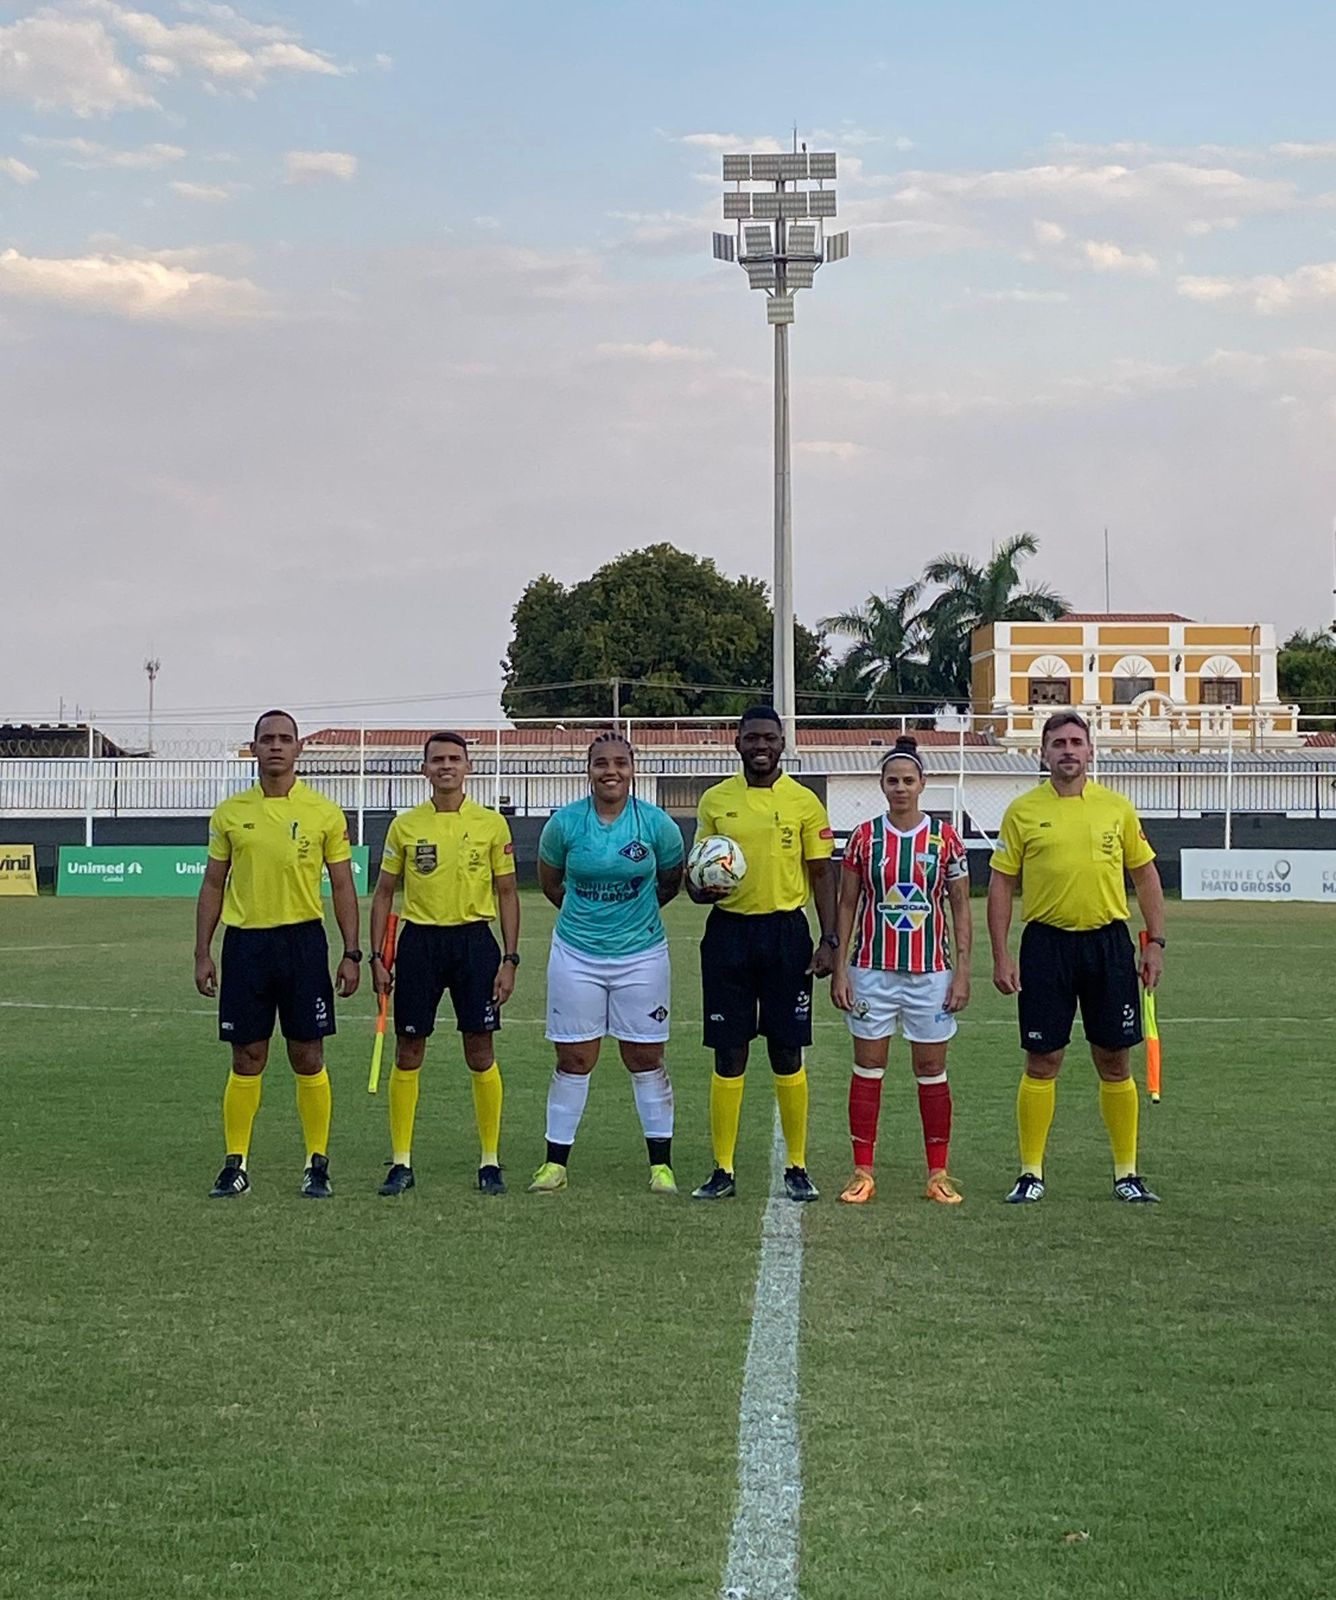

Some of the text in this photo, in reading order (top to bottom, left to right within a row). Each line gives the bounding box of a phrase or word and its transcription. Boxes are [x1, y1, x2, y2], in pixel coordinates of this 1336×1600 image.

[67, 861, 125, 874] Unimed
[1201, 869, 1275, 881] CONHEÇA
[1201, 881, 1292, 893] MATO GROSSO
